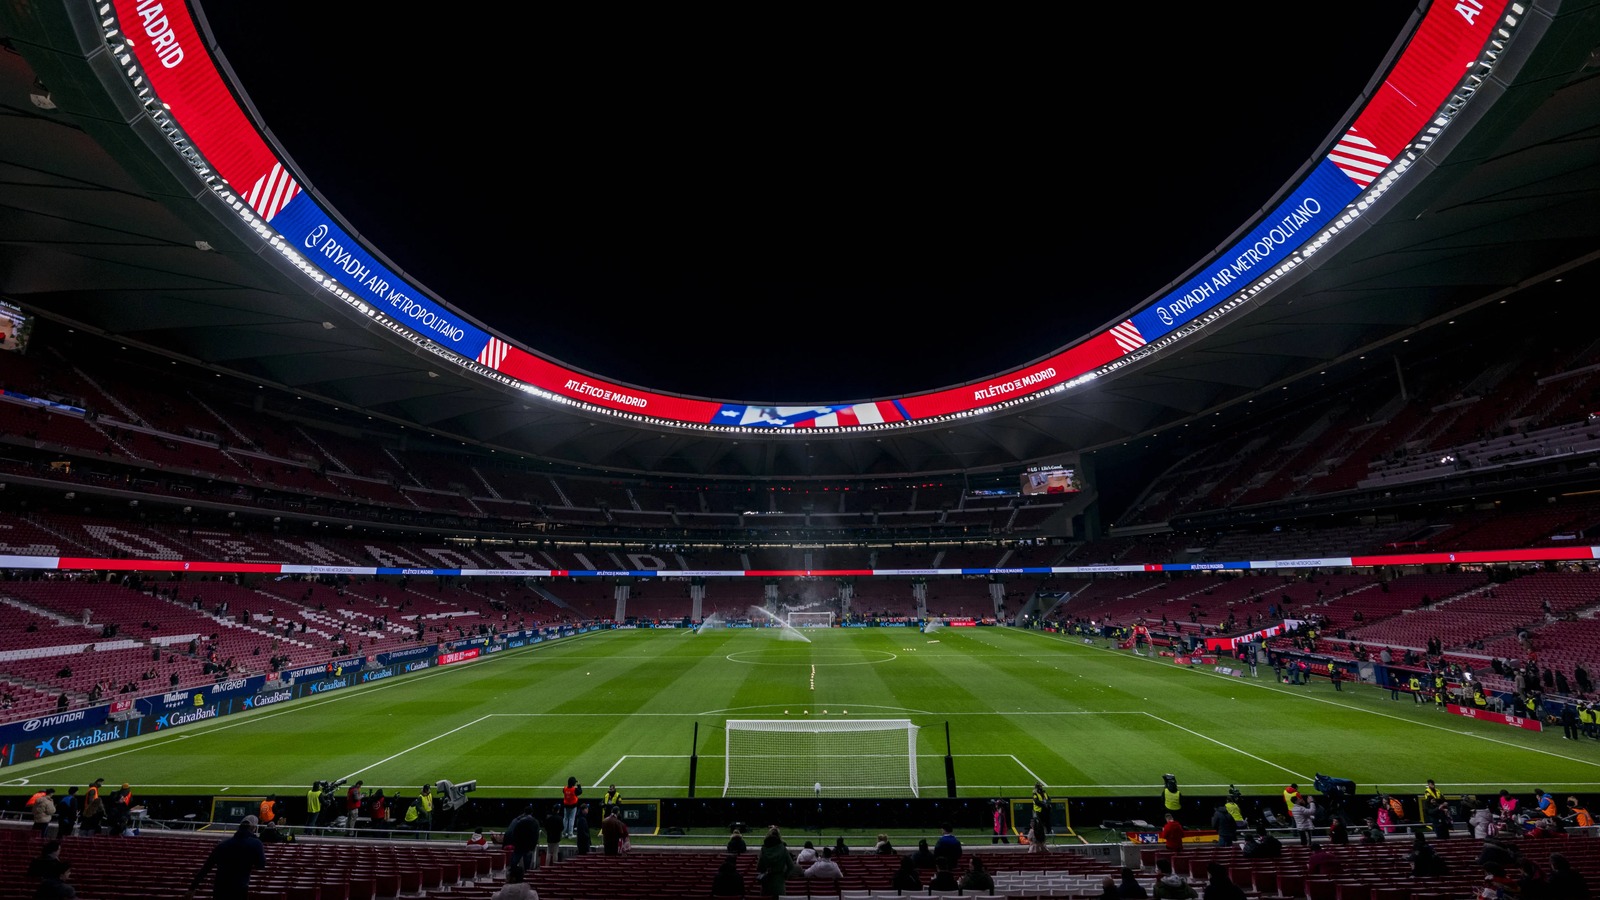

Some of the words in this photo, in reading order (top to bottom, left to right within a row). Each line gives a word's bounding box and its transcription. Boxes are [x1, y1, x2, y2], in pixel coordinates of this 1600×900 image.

[1169, 281, 1215, 317] RIYADH
[1211, 268, 1236, 291] AIR
[1230, 197, 1321, 276] METROPOLITANO
[320, 238, 370, 283] RIYADH
[363, 275, 389, 298] AIR
[385, 288, 464, 342] METROPOLITANO
[564, 379, 604, 398] ATLÉTICO
[611, 392, 647, 408] MADRID
[974, 382, 1015, 401] ATLÉTICO
[1022, 367, 1056, 387] MADRID
[290, 668, 304, 678] VISIT
[163, 691, 189, 703] Mahou
[317, 679, 347, 692] CaixaBank
[42, 711, 85, 728] HYUNDAI
[170, 705, 216, 726] CaixaBank
[57, 726, 120, 751] CaixaBank
